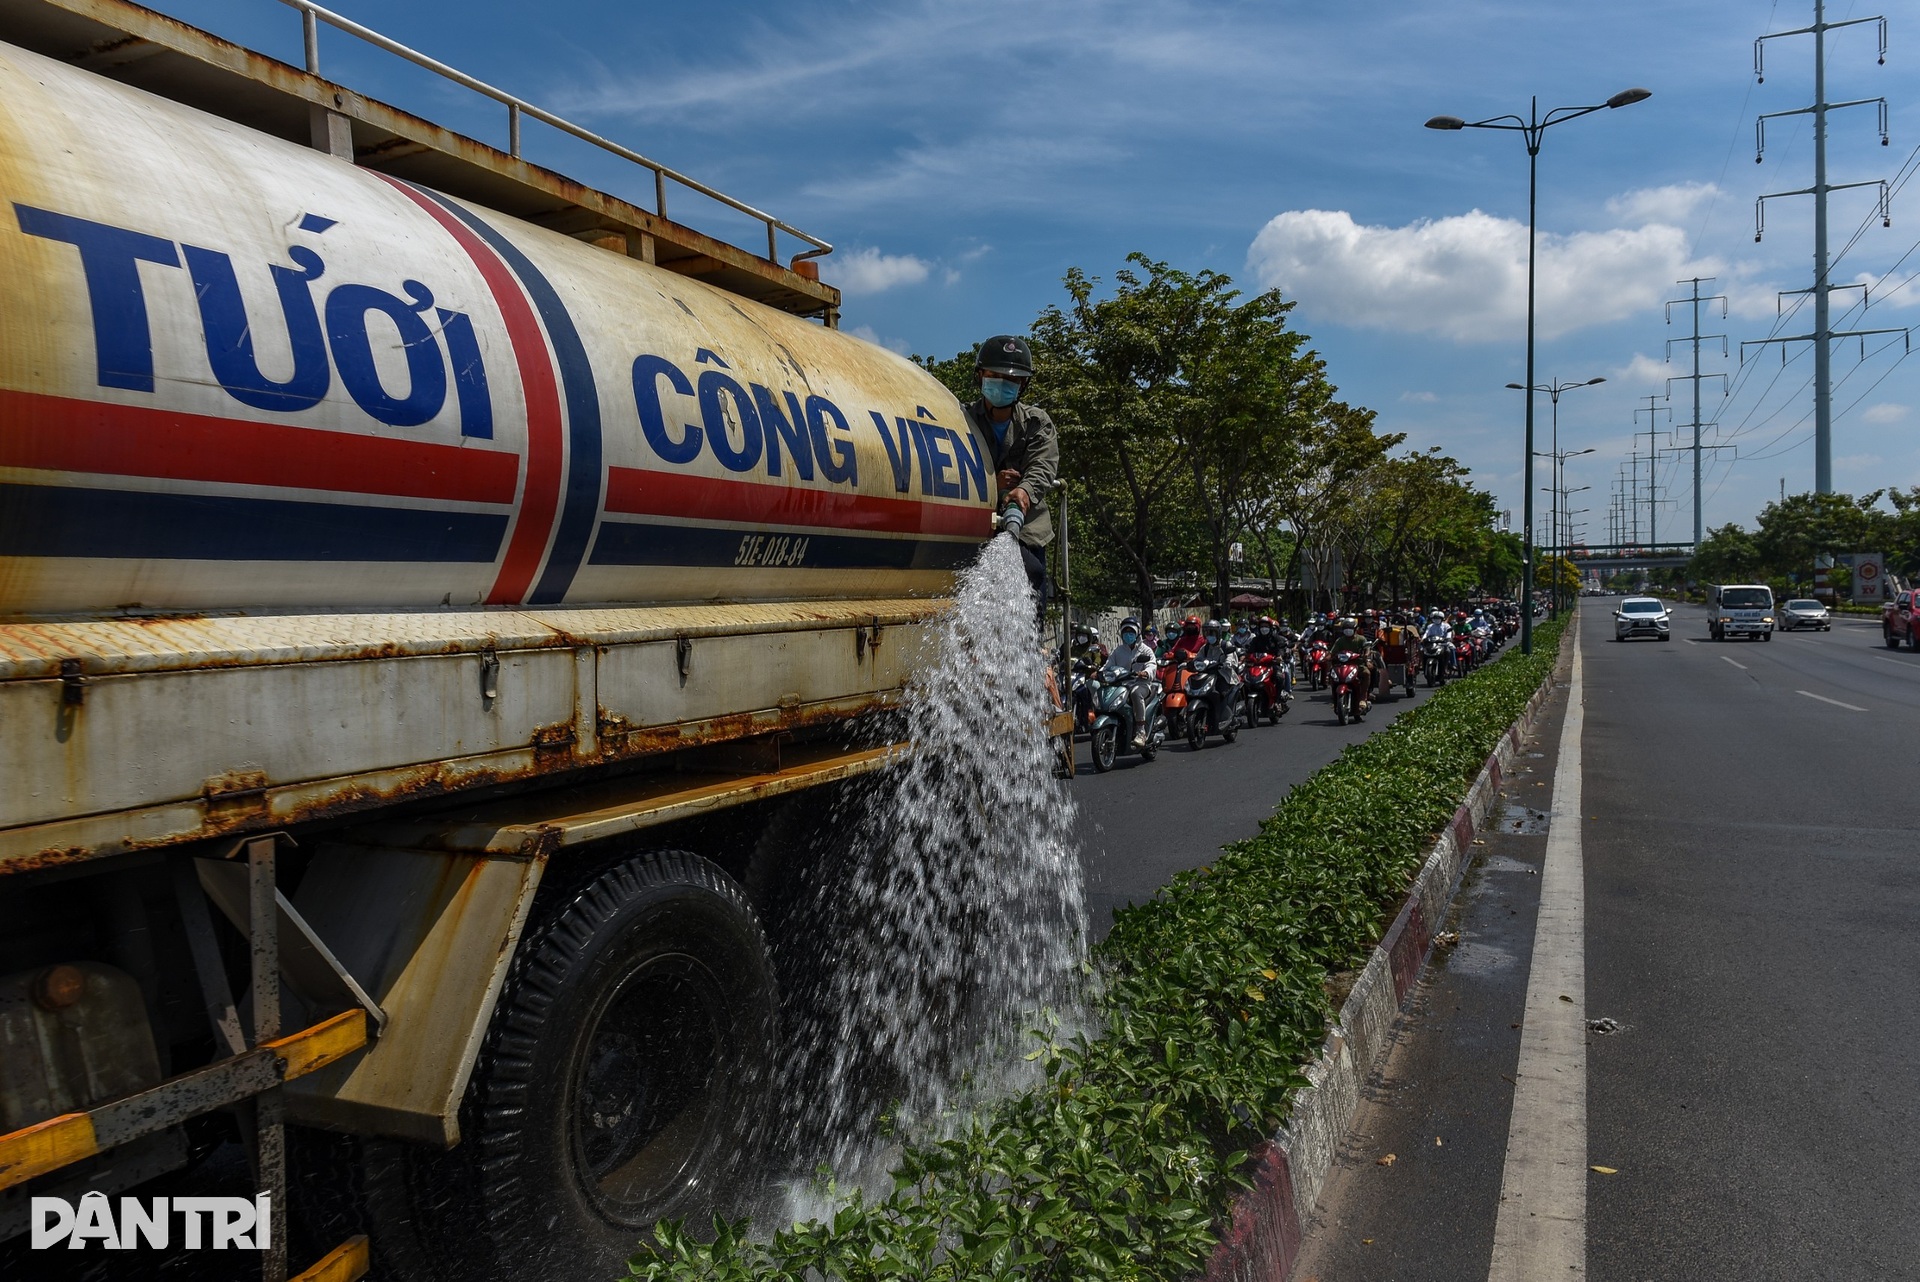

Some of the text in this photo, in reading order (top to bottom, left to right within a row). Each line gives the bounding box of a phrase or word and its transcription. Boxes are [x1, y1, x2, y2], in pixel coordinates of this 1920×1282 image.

[13, 203, 989, 502] TƯỚI CÔNG VIÊN
[734, 535, 810, 566] 51E-018-84
